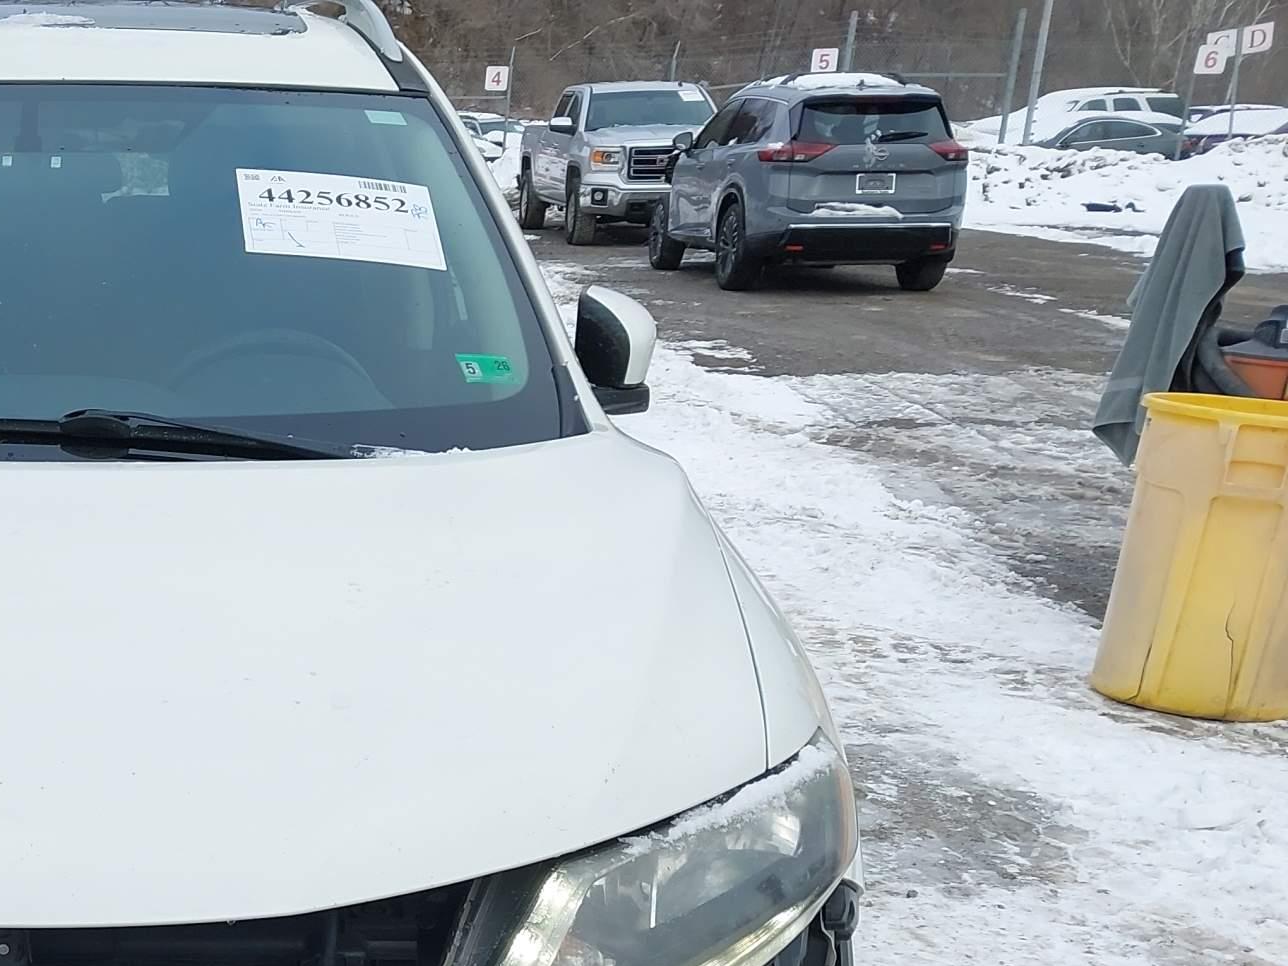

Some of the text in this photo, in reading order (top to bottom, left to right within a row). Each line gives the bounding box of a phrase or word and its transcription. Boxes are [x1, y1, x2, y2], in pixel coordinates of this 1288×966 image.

[1248, 29, 1266, 48] D
[818, 53, 830, 70] 5
[1204, 51, 1219, 69] 6
[491, 71, 502, 86] 4
[258, 187, 410, 214] 44256852
[465, 362, 476, 375] 5
